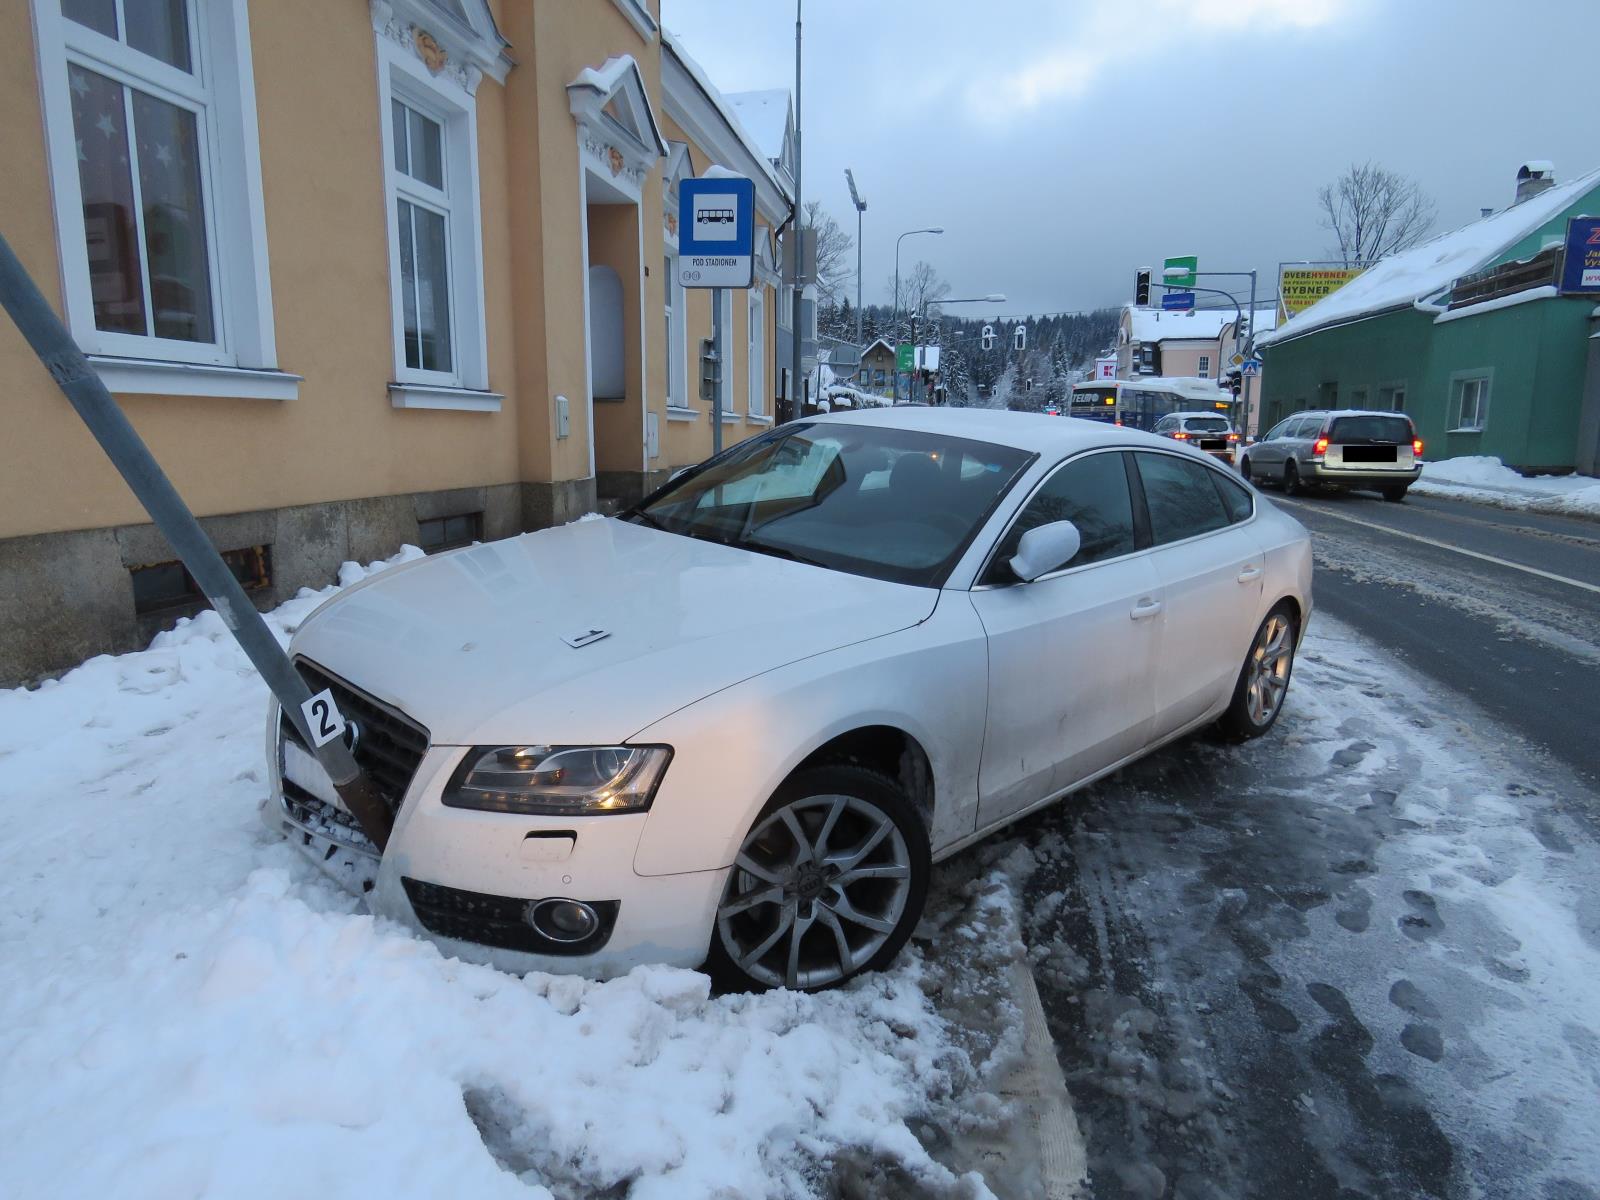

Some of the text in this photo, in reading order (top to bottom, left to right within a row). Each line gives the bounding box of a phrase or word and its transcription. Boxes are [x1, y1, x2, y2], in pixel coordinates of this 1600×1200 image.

[692, 258, 737, 267] POD STADIONEM
[1283, 286, 1330, 295] HYBNER
[311, 699, 337, 738] 2
